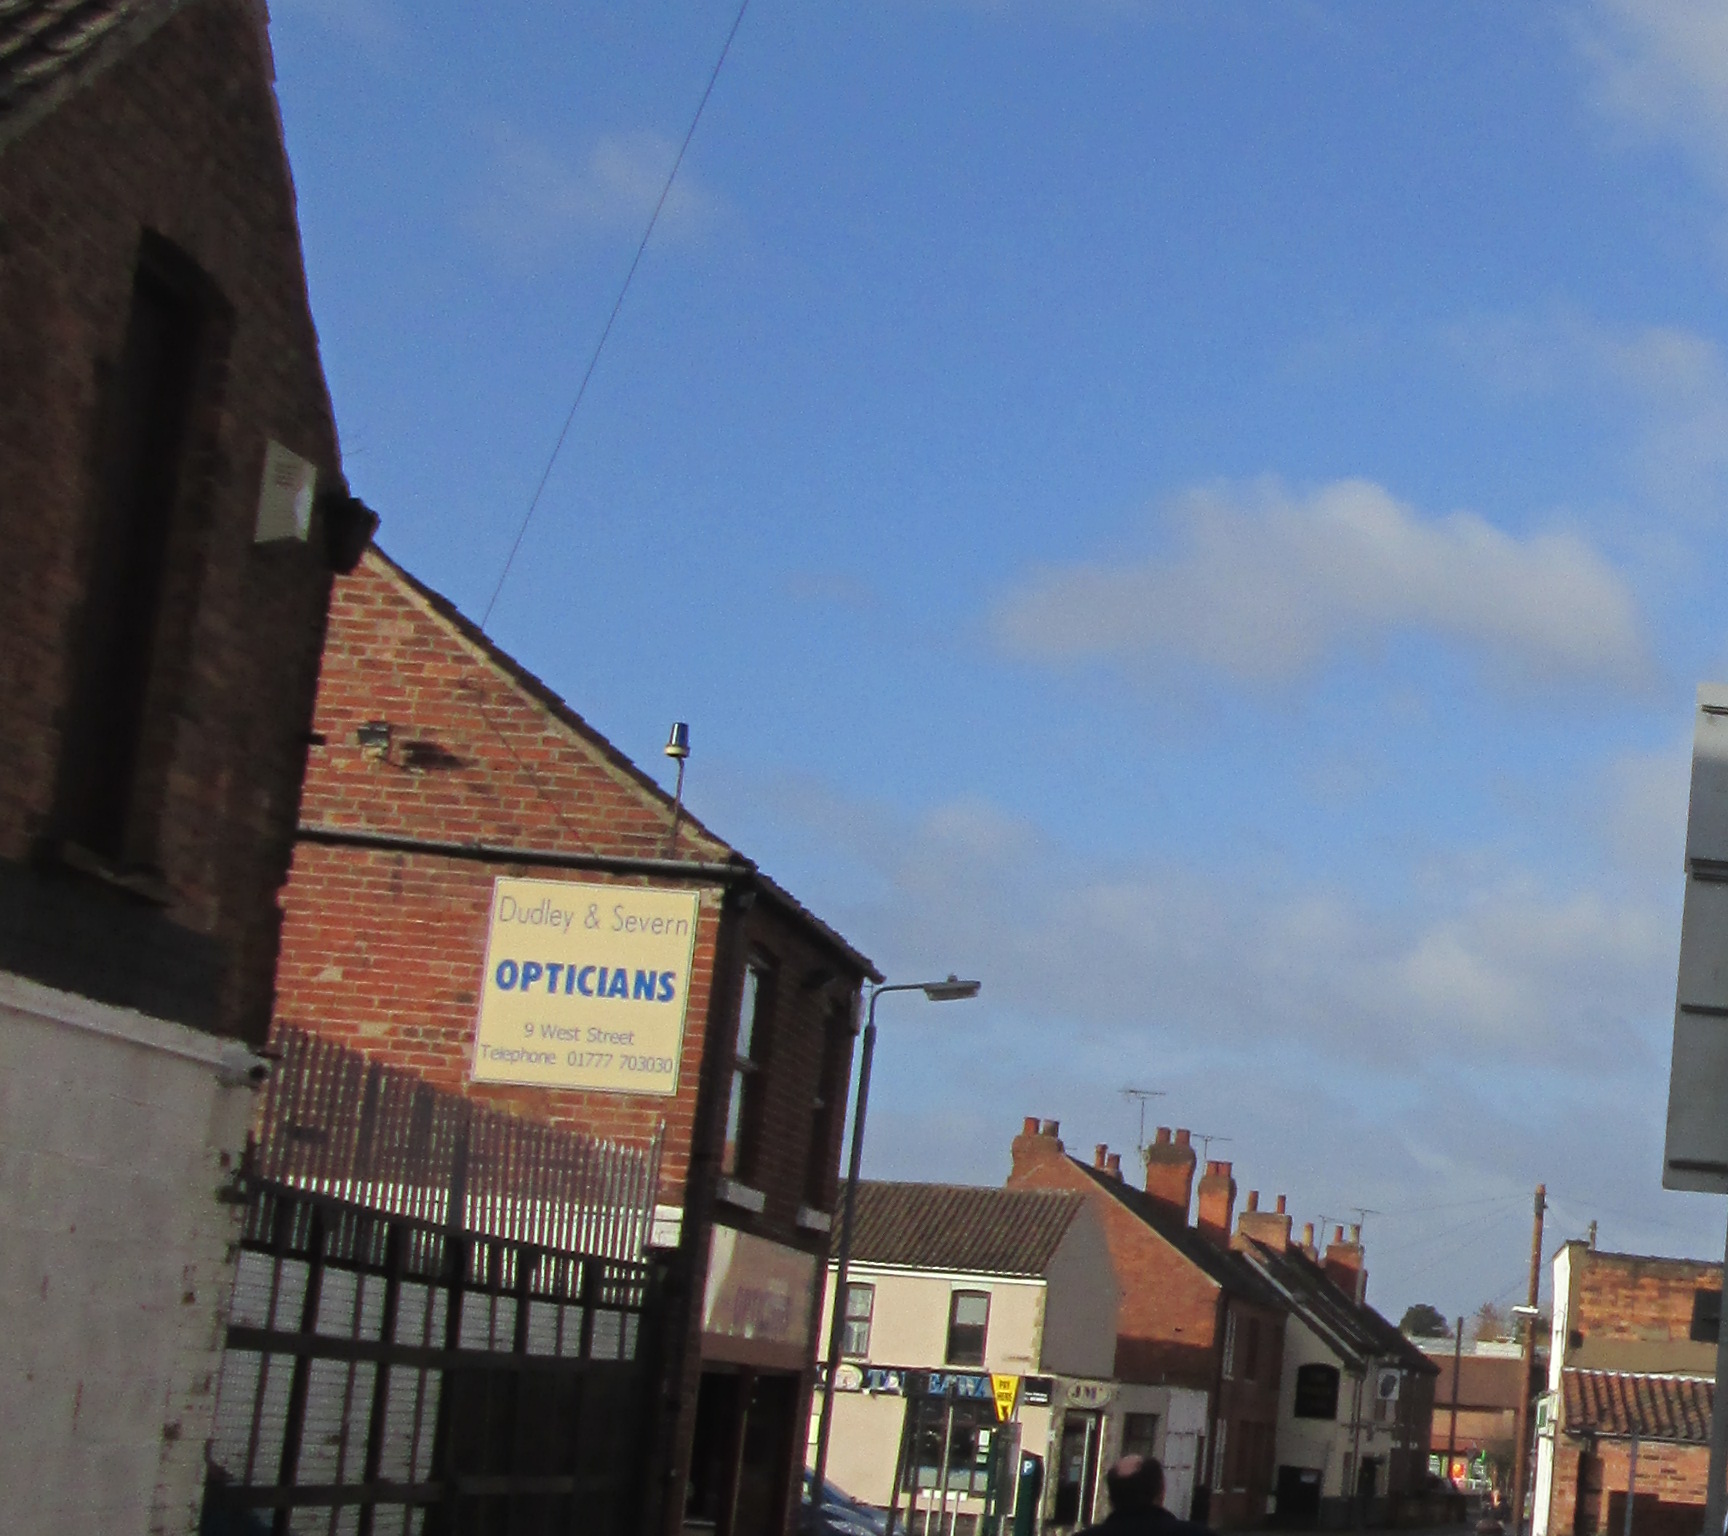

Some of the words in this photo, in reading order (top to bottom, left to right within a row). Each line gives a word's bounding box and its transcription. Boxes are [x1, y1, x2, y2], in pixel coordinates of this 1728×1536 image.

[499, 896, 573, 933] Dudley
[584, 904, 600, 929] &
[612, 906, 689, 936] Severn
[495, 959, 677, 1003] OPTICIANS
[525, 1024, 534, 1037] 9
[541, 1025, 581, 1042] West
[586, 1028, 635, 1046] Street
[481, 1044, 556, 1065] Telephone
[567, 1051, 613, 1067] 01777
[619, 1055, 673, 1073] 703030
